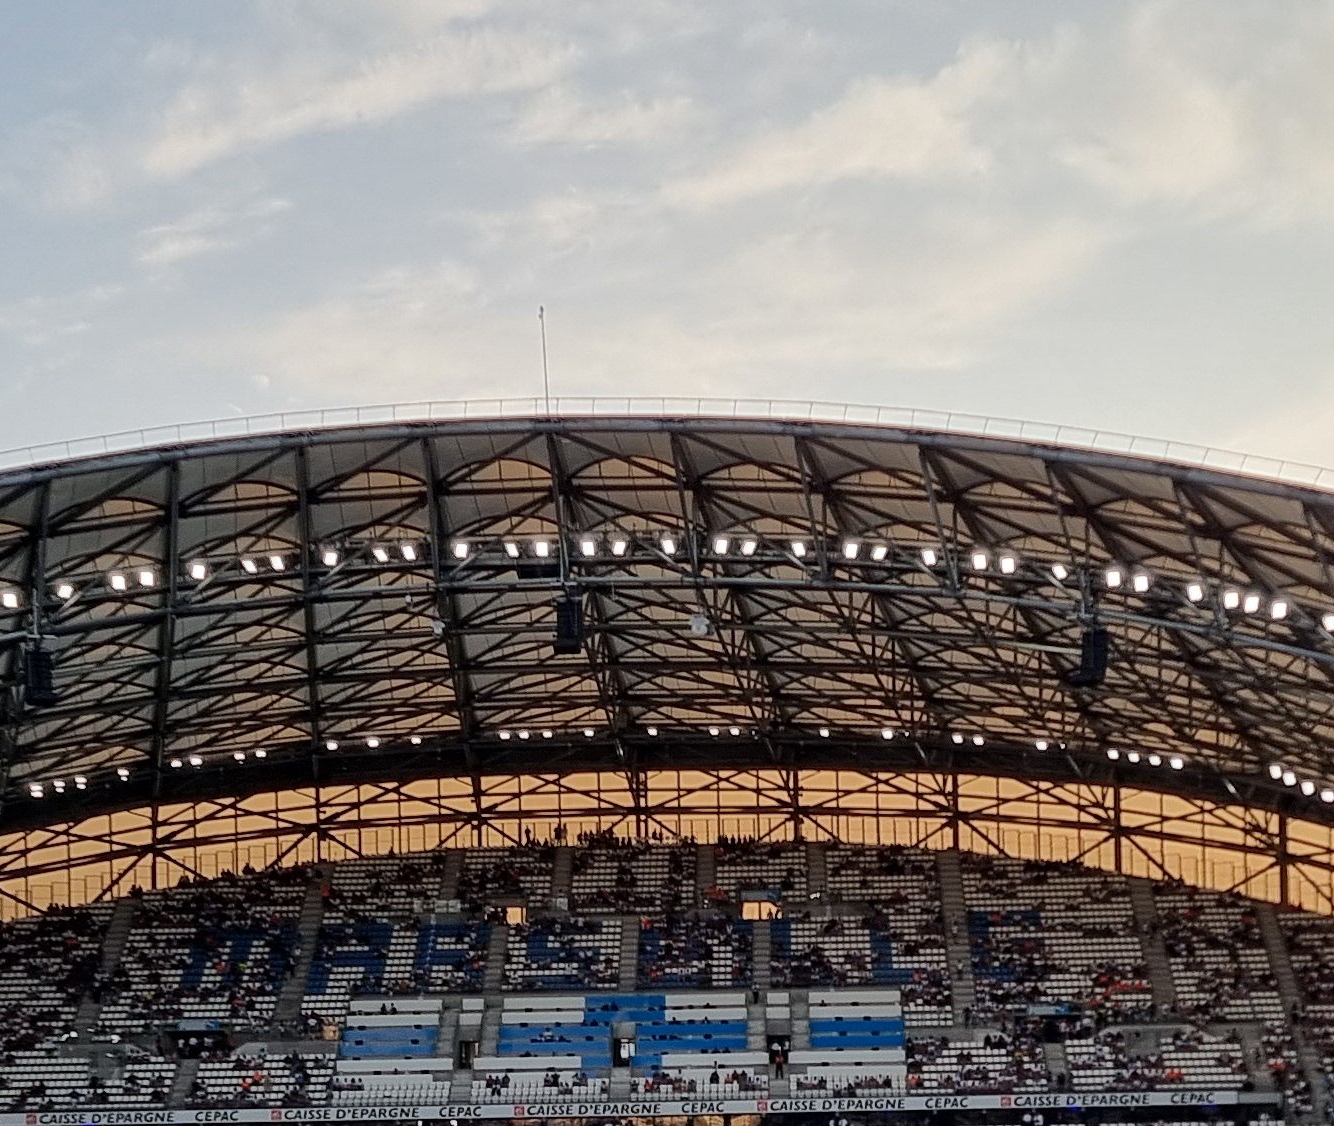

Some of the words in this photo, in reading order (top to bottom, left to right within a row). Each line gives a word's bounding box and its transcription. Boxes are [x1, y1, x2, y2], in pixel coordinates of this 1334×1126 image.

[770, 1101, 816, 1112] CAISSE
[822, 1099, 905, 1111] D'EPARGNE
[924, 1098, 968, 1109] CEPAC
[1014, 1095, 1061, 1107] CAISSE
[1068, 1093, 1151, 1105] D'EPARGNE
[1170, 1092, 1215, 1104] CEPAC
[285, 1109, 331, 1120] CAISSE
[336, 1108, 419, 1120] D'EPARGNE
[439, 1106, 482, 1117] CEPAC
[527, 1105, 573, 1116] CAISSE
[578, 1103, 661, 1115] D'EPARGNE
[681, 1102, 725, 1113] CEPAC
[40, 1114, 85, 1125] CAISSE
[92, 1112, 175, 1124] D'EPARGNE
[195, 1111, 239, 1121] CEPAC
